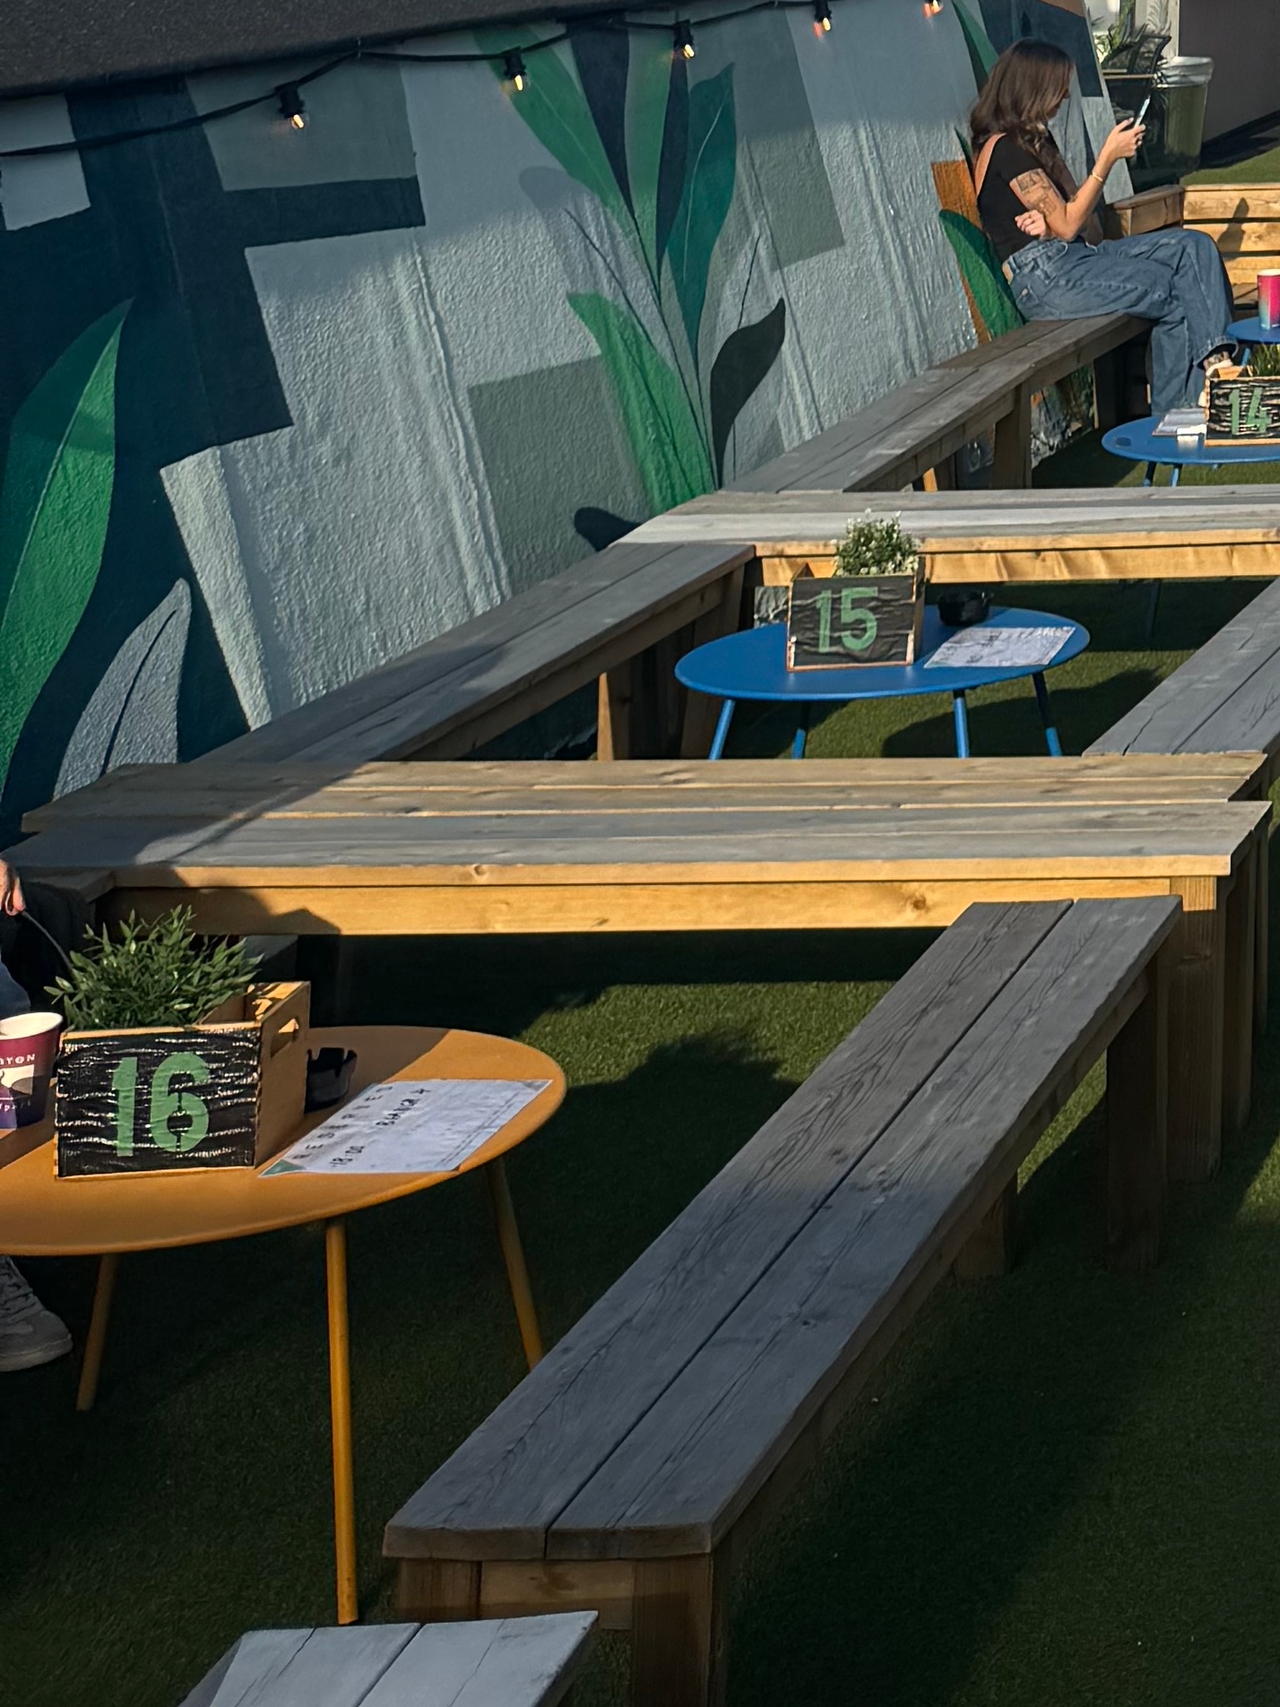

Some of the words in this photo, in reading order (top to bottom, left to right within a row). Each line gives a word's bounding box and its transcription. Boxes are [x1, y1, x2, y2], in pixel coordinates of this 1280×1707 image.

[1228, 386, 1273, 435] 14
[815, 586, 878, 654] 15
[111, 1051, 210, 1157] 16
